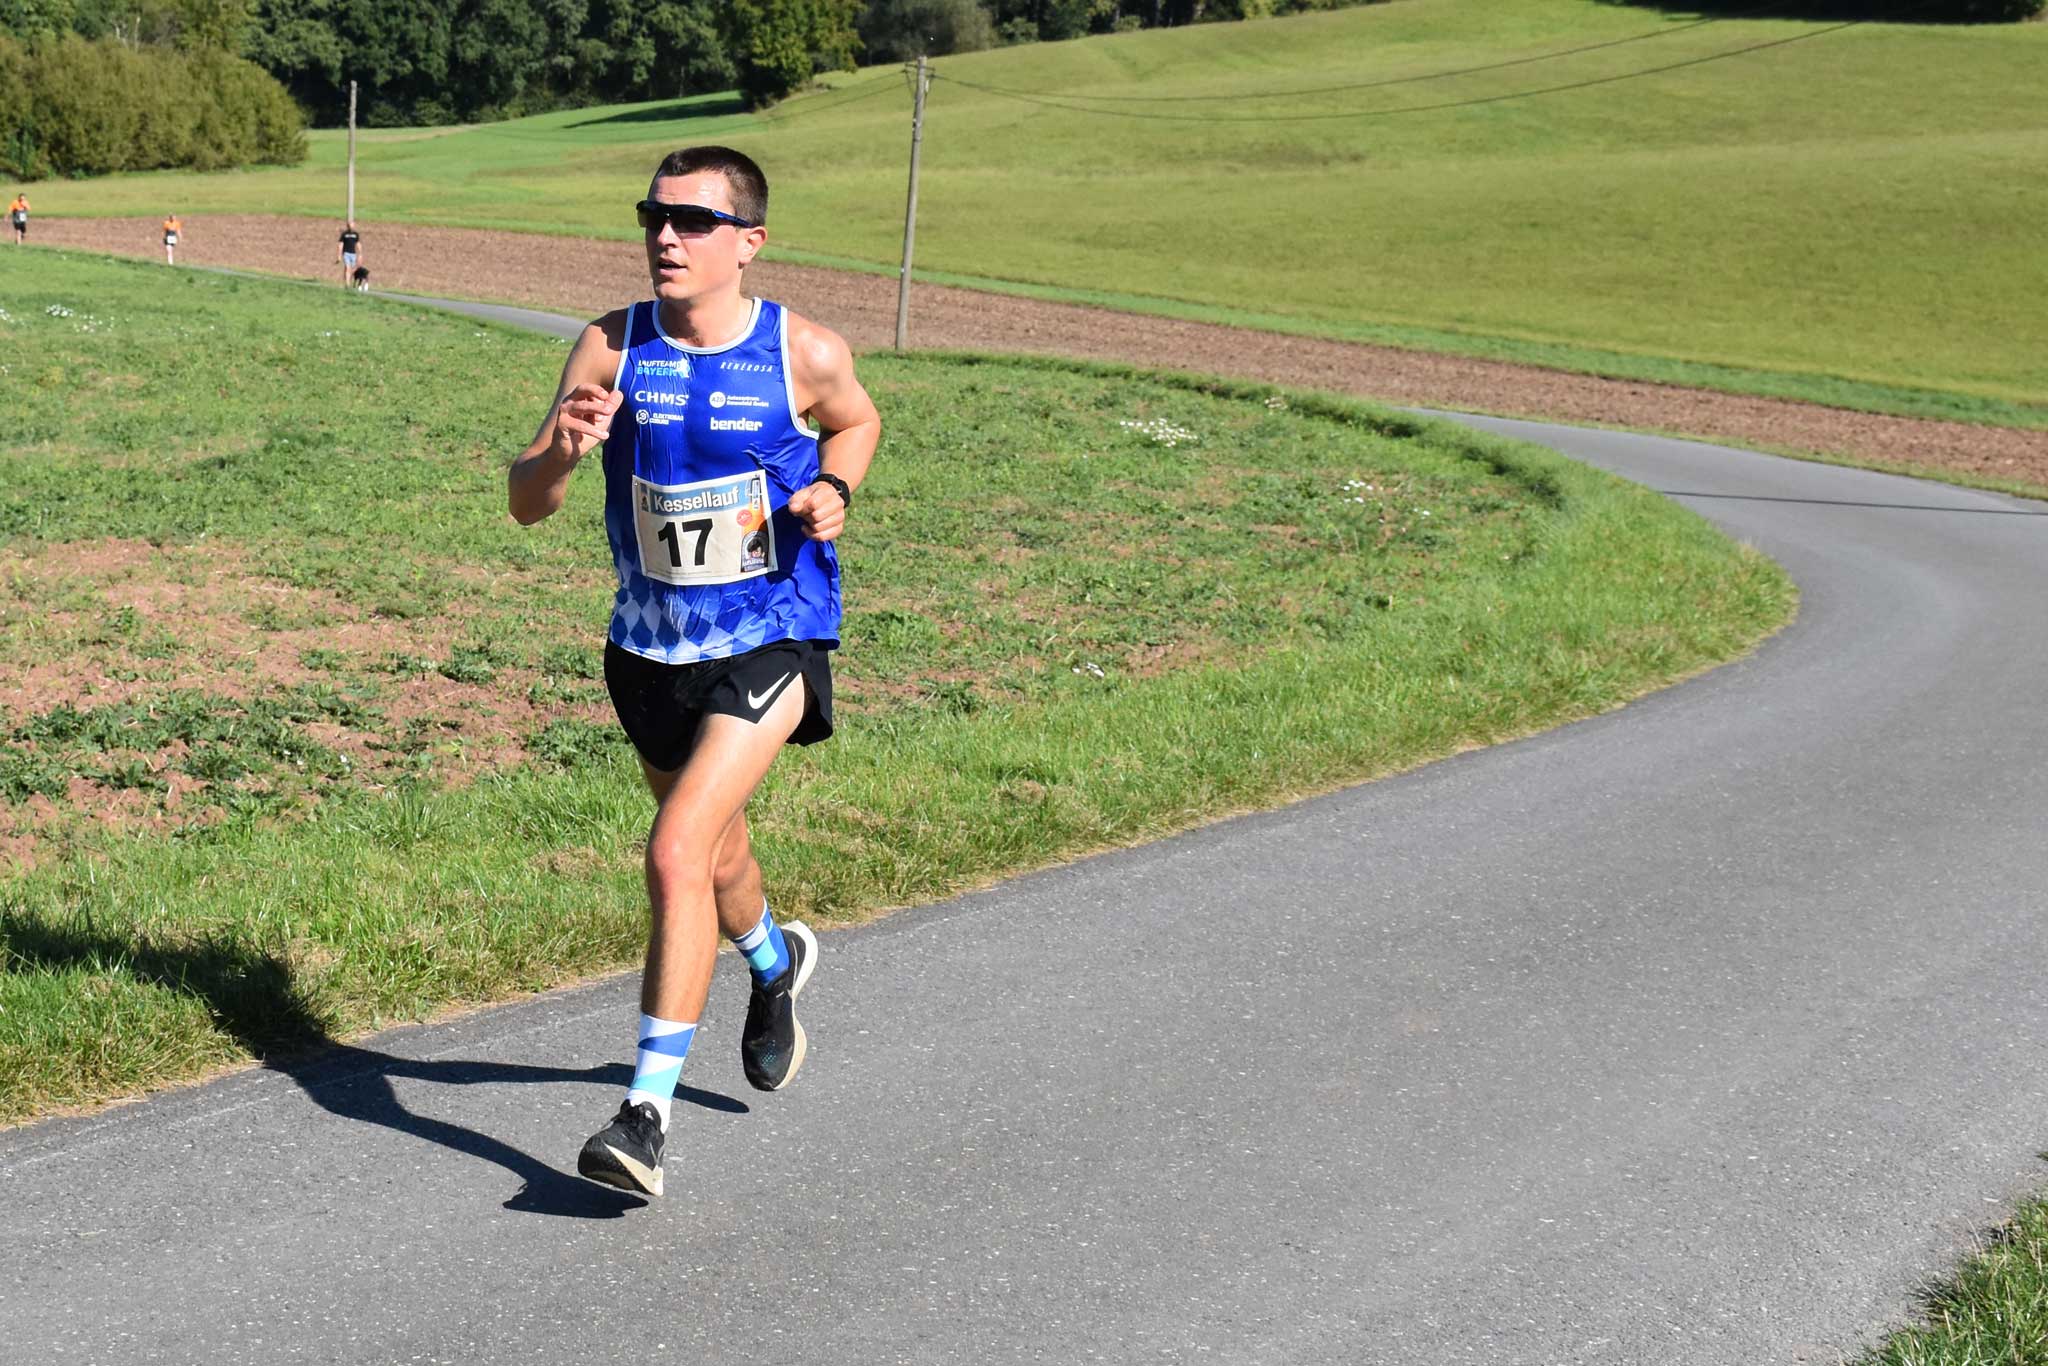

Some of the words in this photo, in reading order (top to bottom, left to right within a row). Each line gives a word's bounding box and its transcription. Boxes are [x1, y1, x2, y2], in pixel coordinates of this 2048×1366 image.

[635, 390, 687, 406] CHMS
[710, 416, 763, 431] bender
[654, 486, 739, 513] Kessellauf
[658, 518, 713, 567] 17
